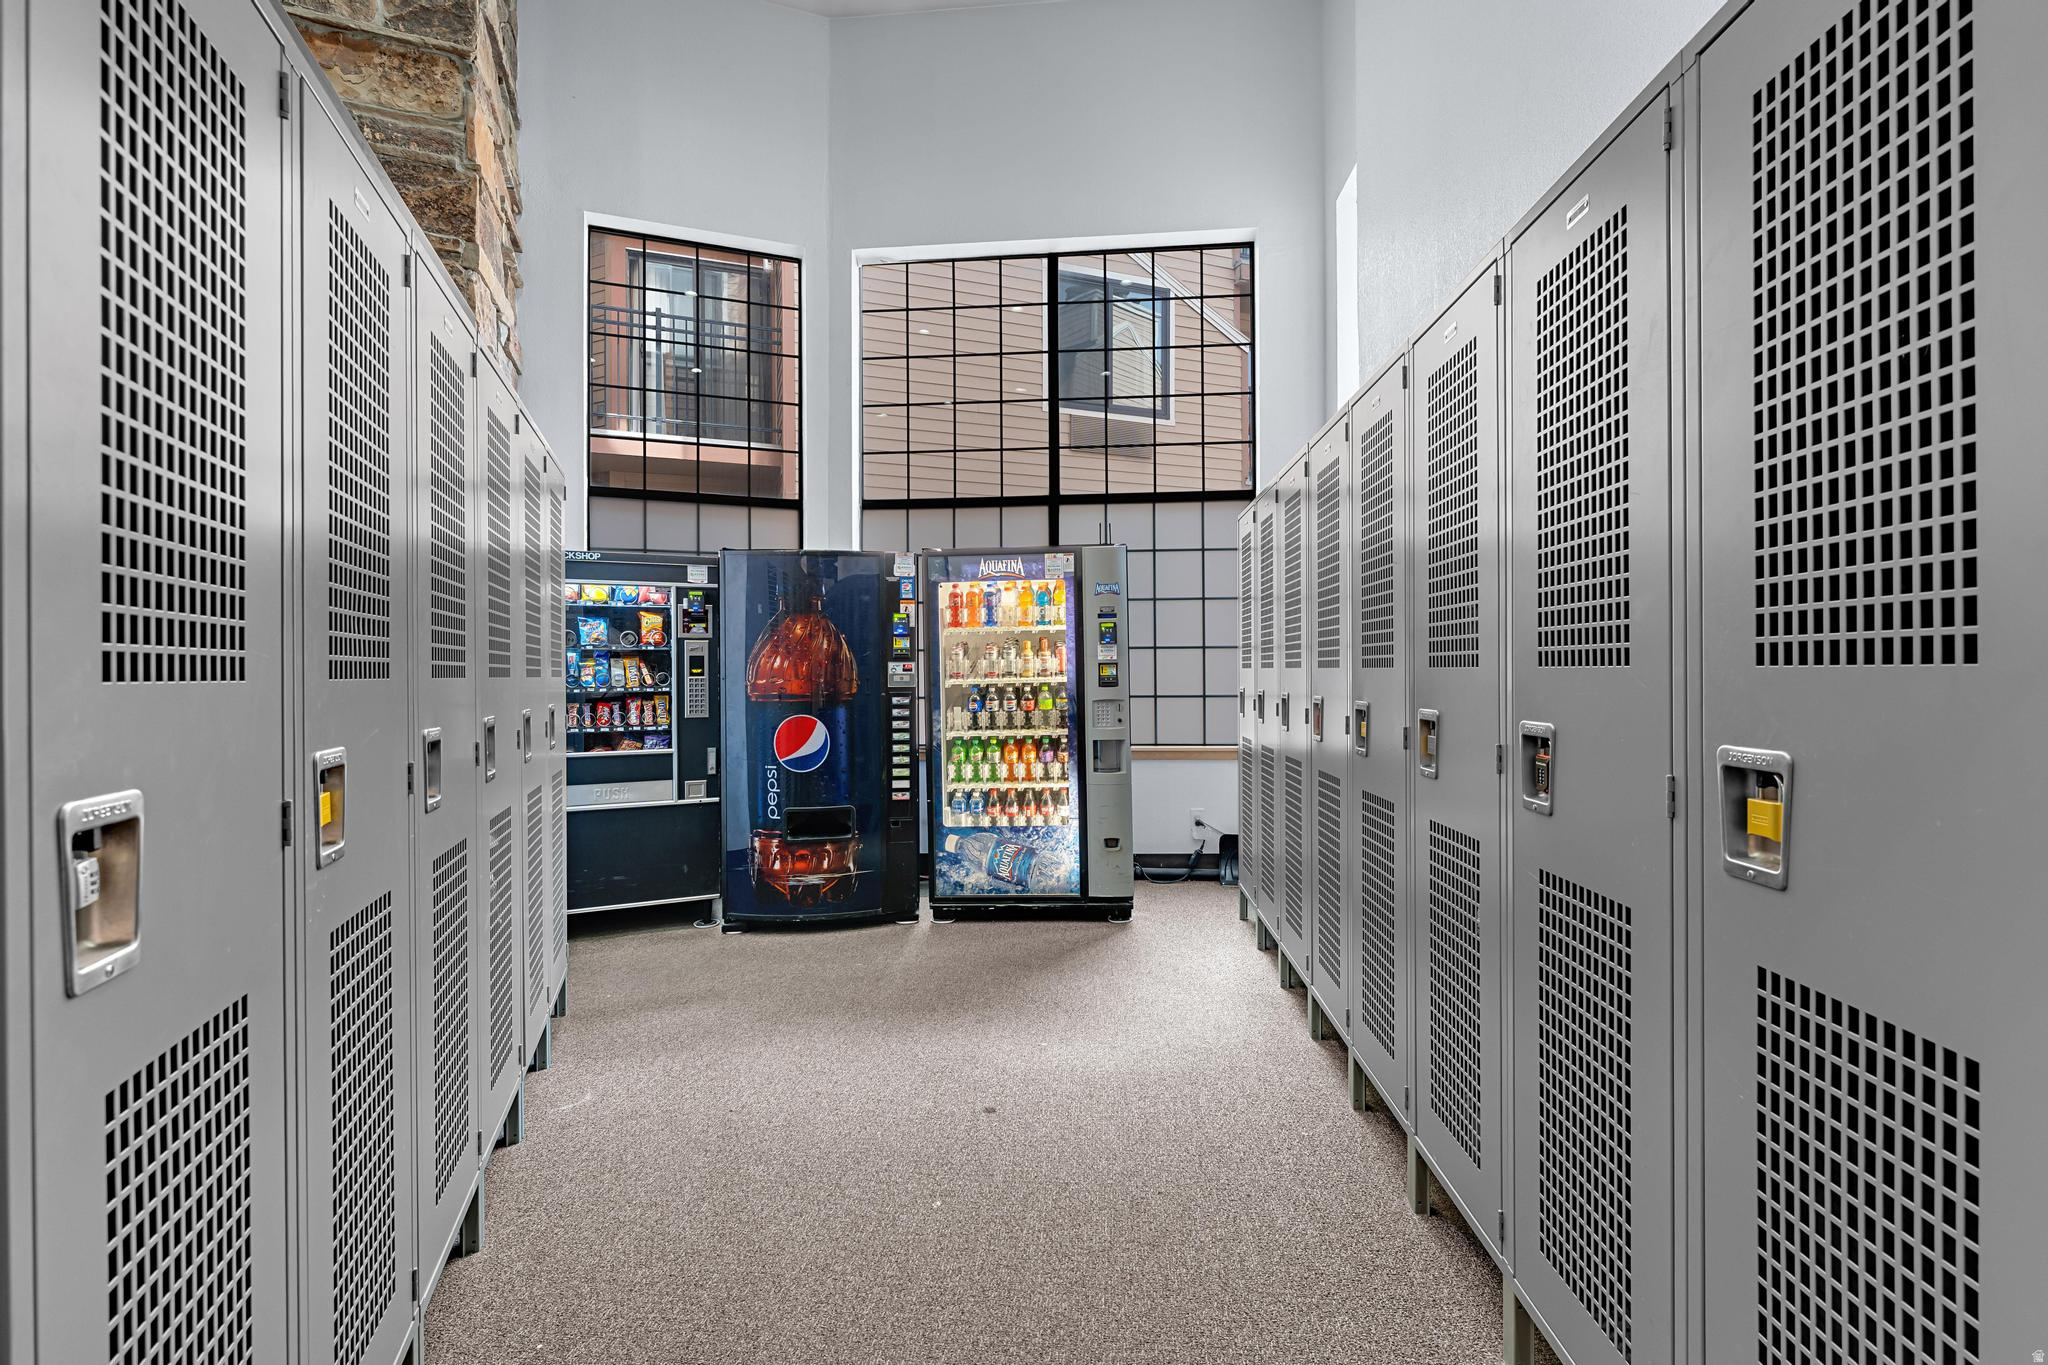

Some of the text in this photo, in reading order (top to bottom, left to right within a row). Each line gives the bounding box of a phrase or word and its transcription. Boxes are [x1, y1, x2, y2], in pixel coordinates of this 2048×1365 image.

[978, 556, 1025, 578] AQUAFINA
[1095, 582, 1120, 595] AQUAFINA
[593, 787, 631, 800] PUSH
[765, 765, 780, 819] pepsi
